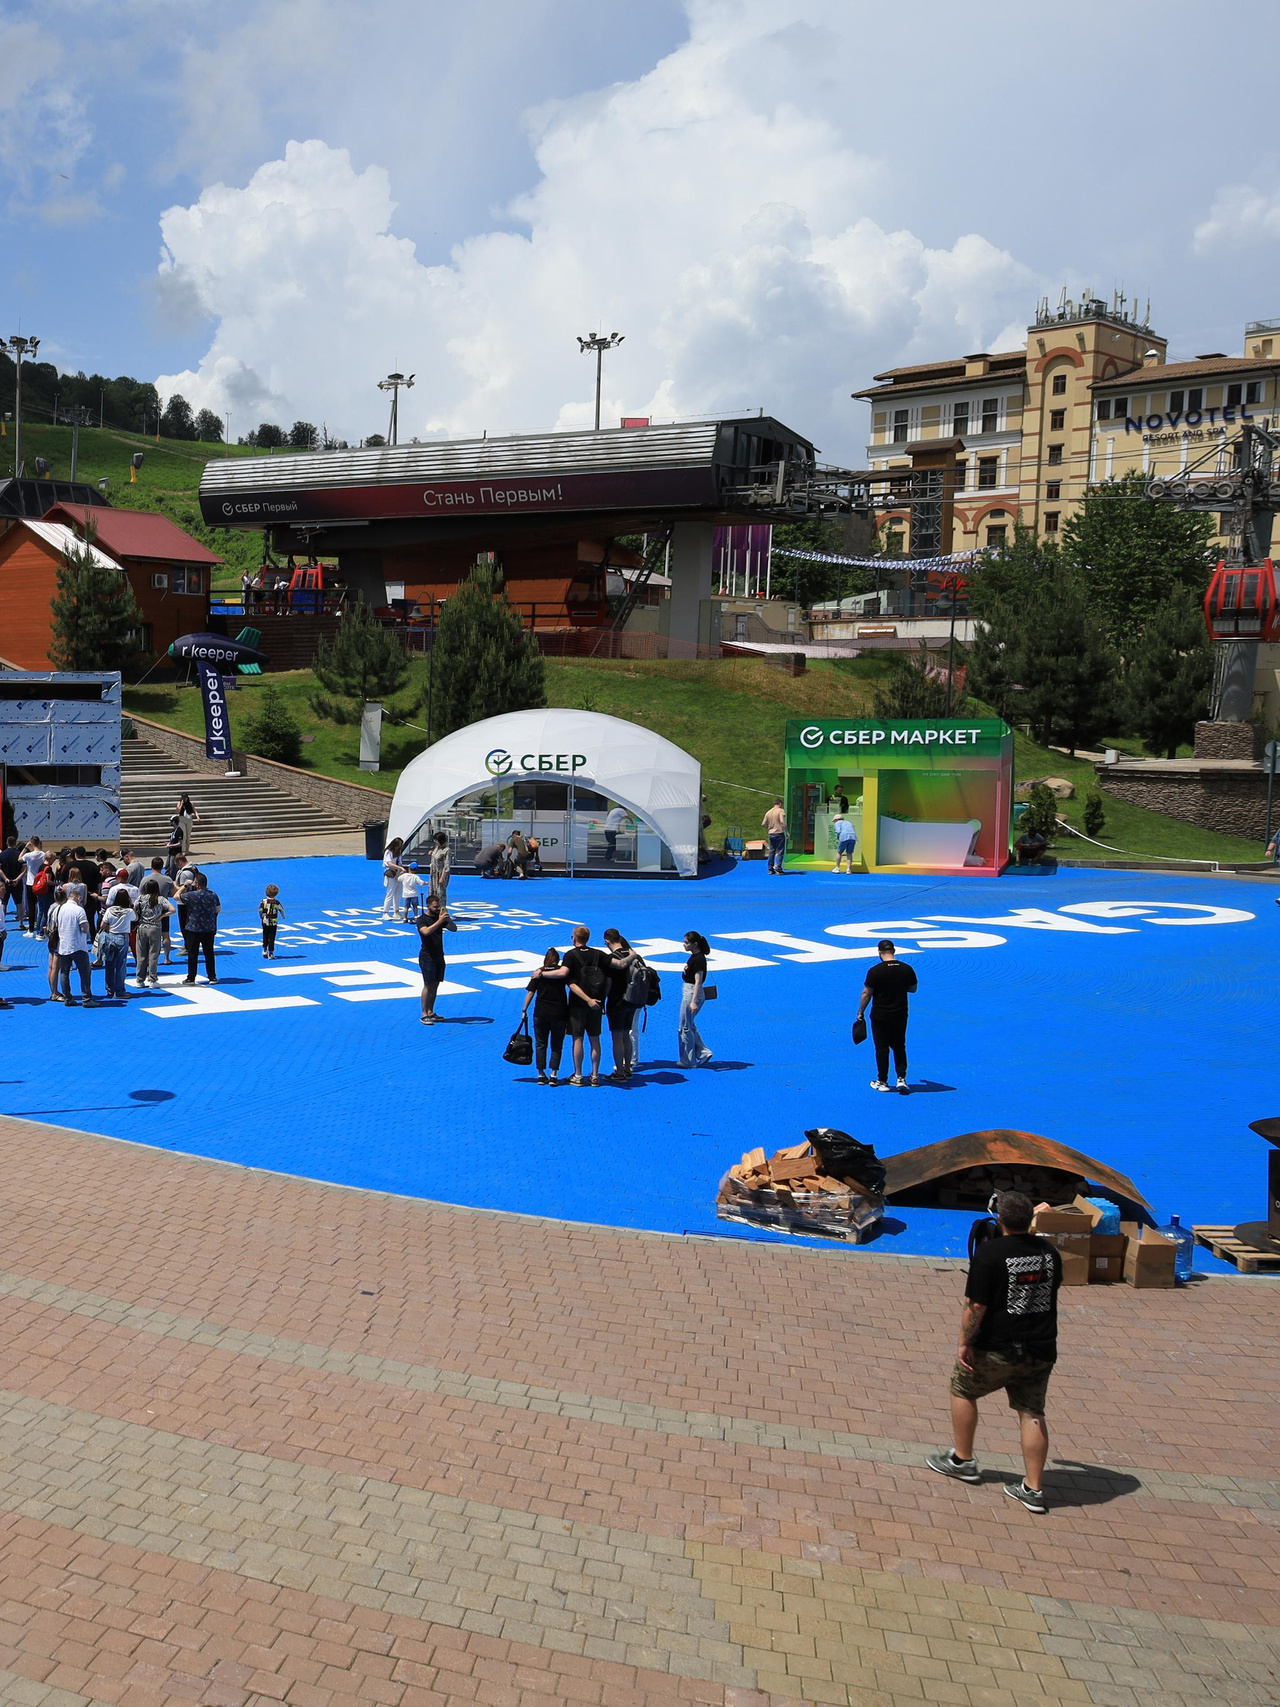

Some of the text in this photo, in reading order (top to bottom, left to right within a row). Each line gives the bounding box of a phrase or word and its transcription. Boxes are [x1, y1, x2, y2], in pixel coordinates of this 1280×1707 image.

[1125, 403, 1254, 432] NOVOTEL
[1142, 427, 1225, 442] RESORT AND SPA
[423, 484, 563, 506] Стань Первым!
[235, 501, 298, 513] СБЕР Первый
[829, 729, 982, 745] СБЕР МАРКЕТ
[520, 754, 587, 771] СБЕР
[124, 900, 1257, 1018] GASTREET
